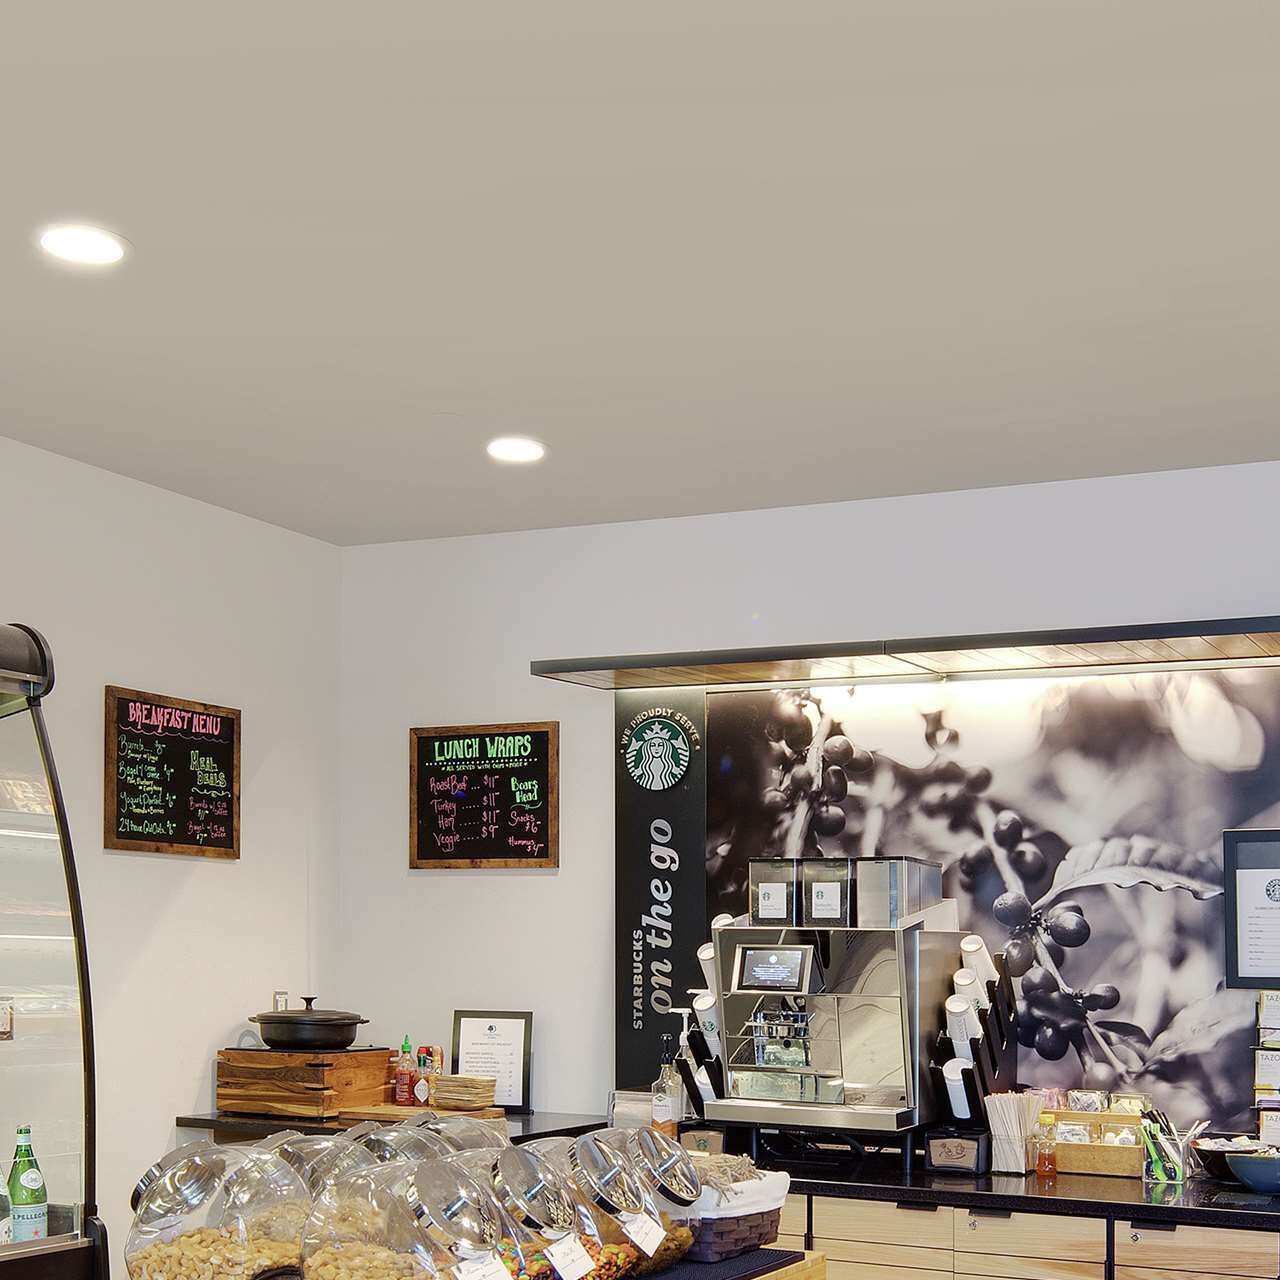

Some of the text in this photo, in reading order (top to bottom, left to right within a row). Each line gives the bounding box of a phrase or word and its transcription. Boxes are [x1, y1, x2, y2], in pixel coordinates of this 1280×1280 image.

[128, 702, 222, 736] BREAKFAST MENU
[621, 707, 700, 745] WE PROUDLY SERVE
[190, 751, 219, 772] MEAL
[434, 735, 532, 762] LUNCH WRAPS
[197, 771, 227, 788] DEALS
[515, 787, 538, 803] Head
[641, 818, 680, 1015] on the go
[633, 928, 644, 1030] STARBUCKS
[1260, 1054, 1280, 1062] TAZO
